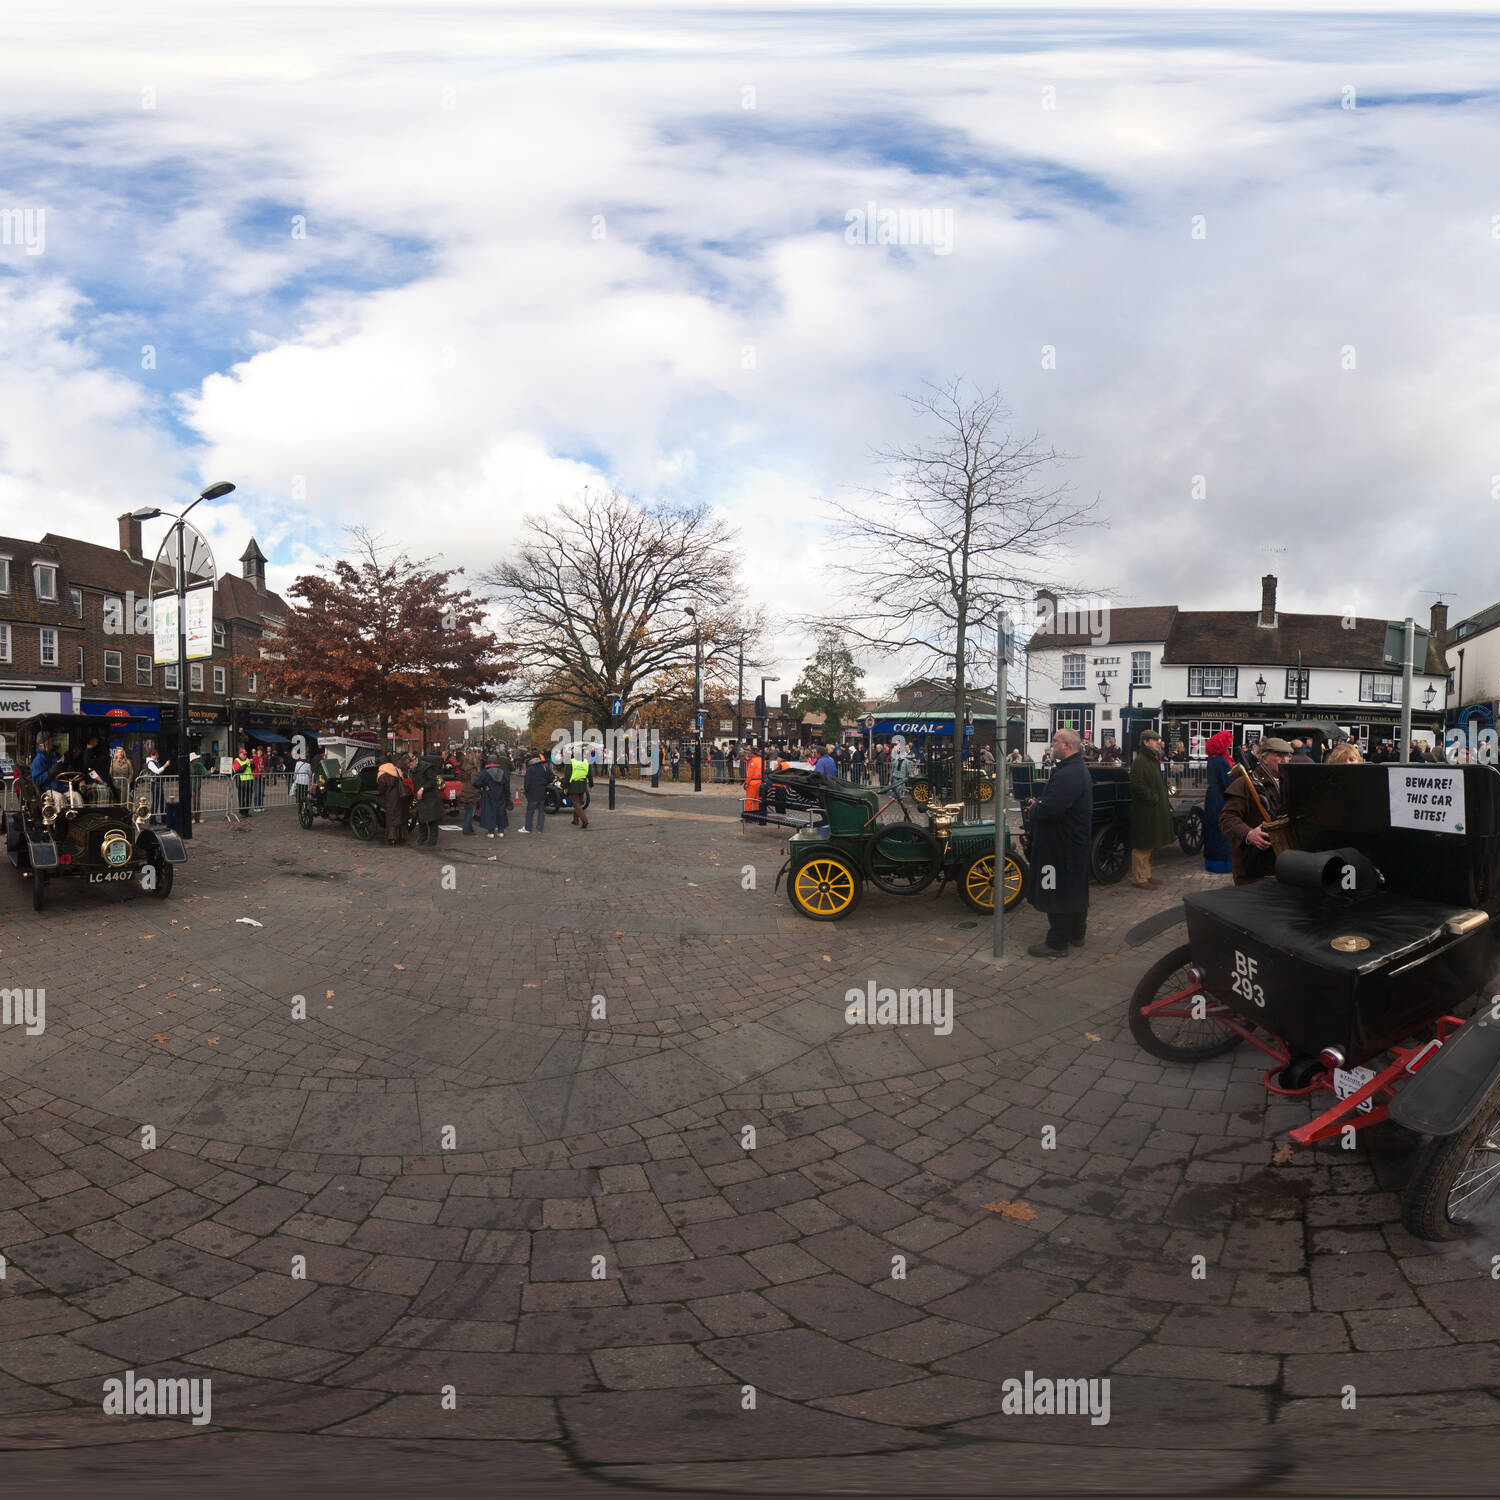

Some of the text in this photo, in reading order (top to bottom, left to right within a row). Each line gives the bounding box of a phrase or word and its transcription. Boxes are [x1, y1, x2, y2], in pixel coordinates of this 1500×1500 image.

[1096, 670, 1118, 678] HART
[0, 699, 31, 711] west
[893, 723, 936, 733] CORAL
[1406, 777, 1452, 790] BEWARE!
[1406, 793, 1452, 807] THIS CAR
[1414, 810, 1446, 822] BITES!
[111, 855, 125, 863] 600
[89, 871, 134, 883] LC 4407
[1234, 950, 1258, 980] BF
[1231, 972, 1266, 1008] 293
